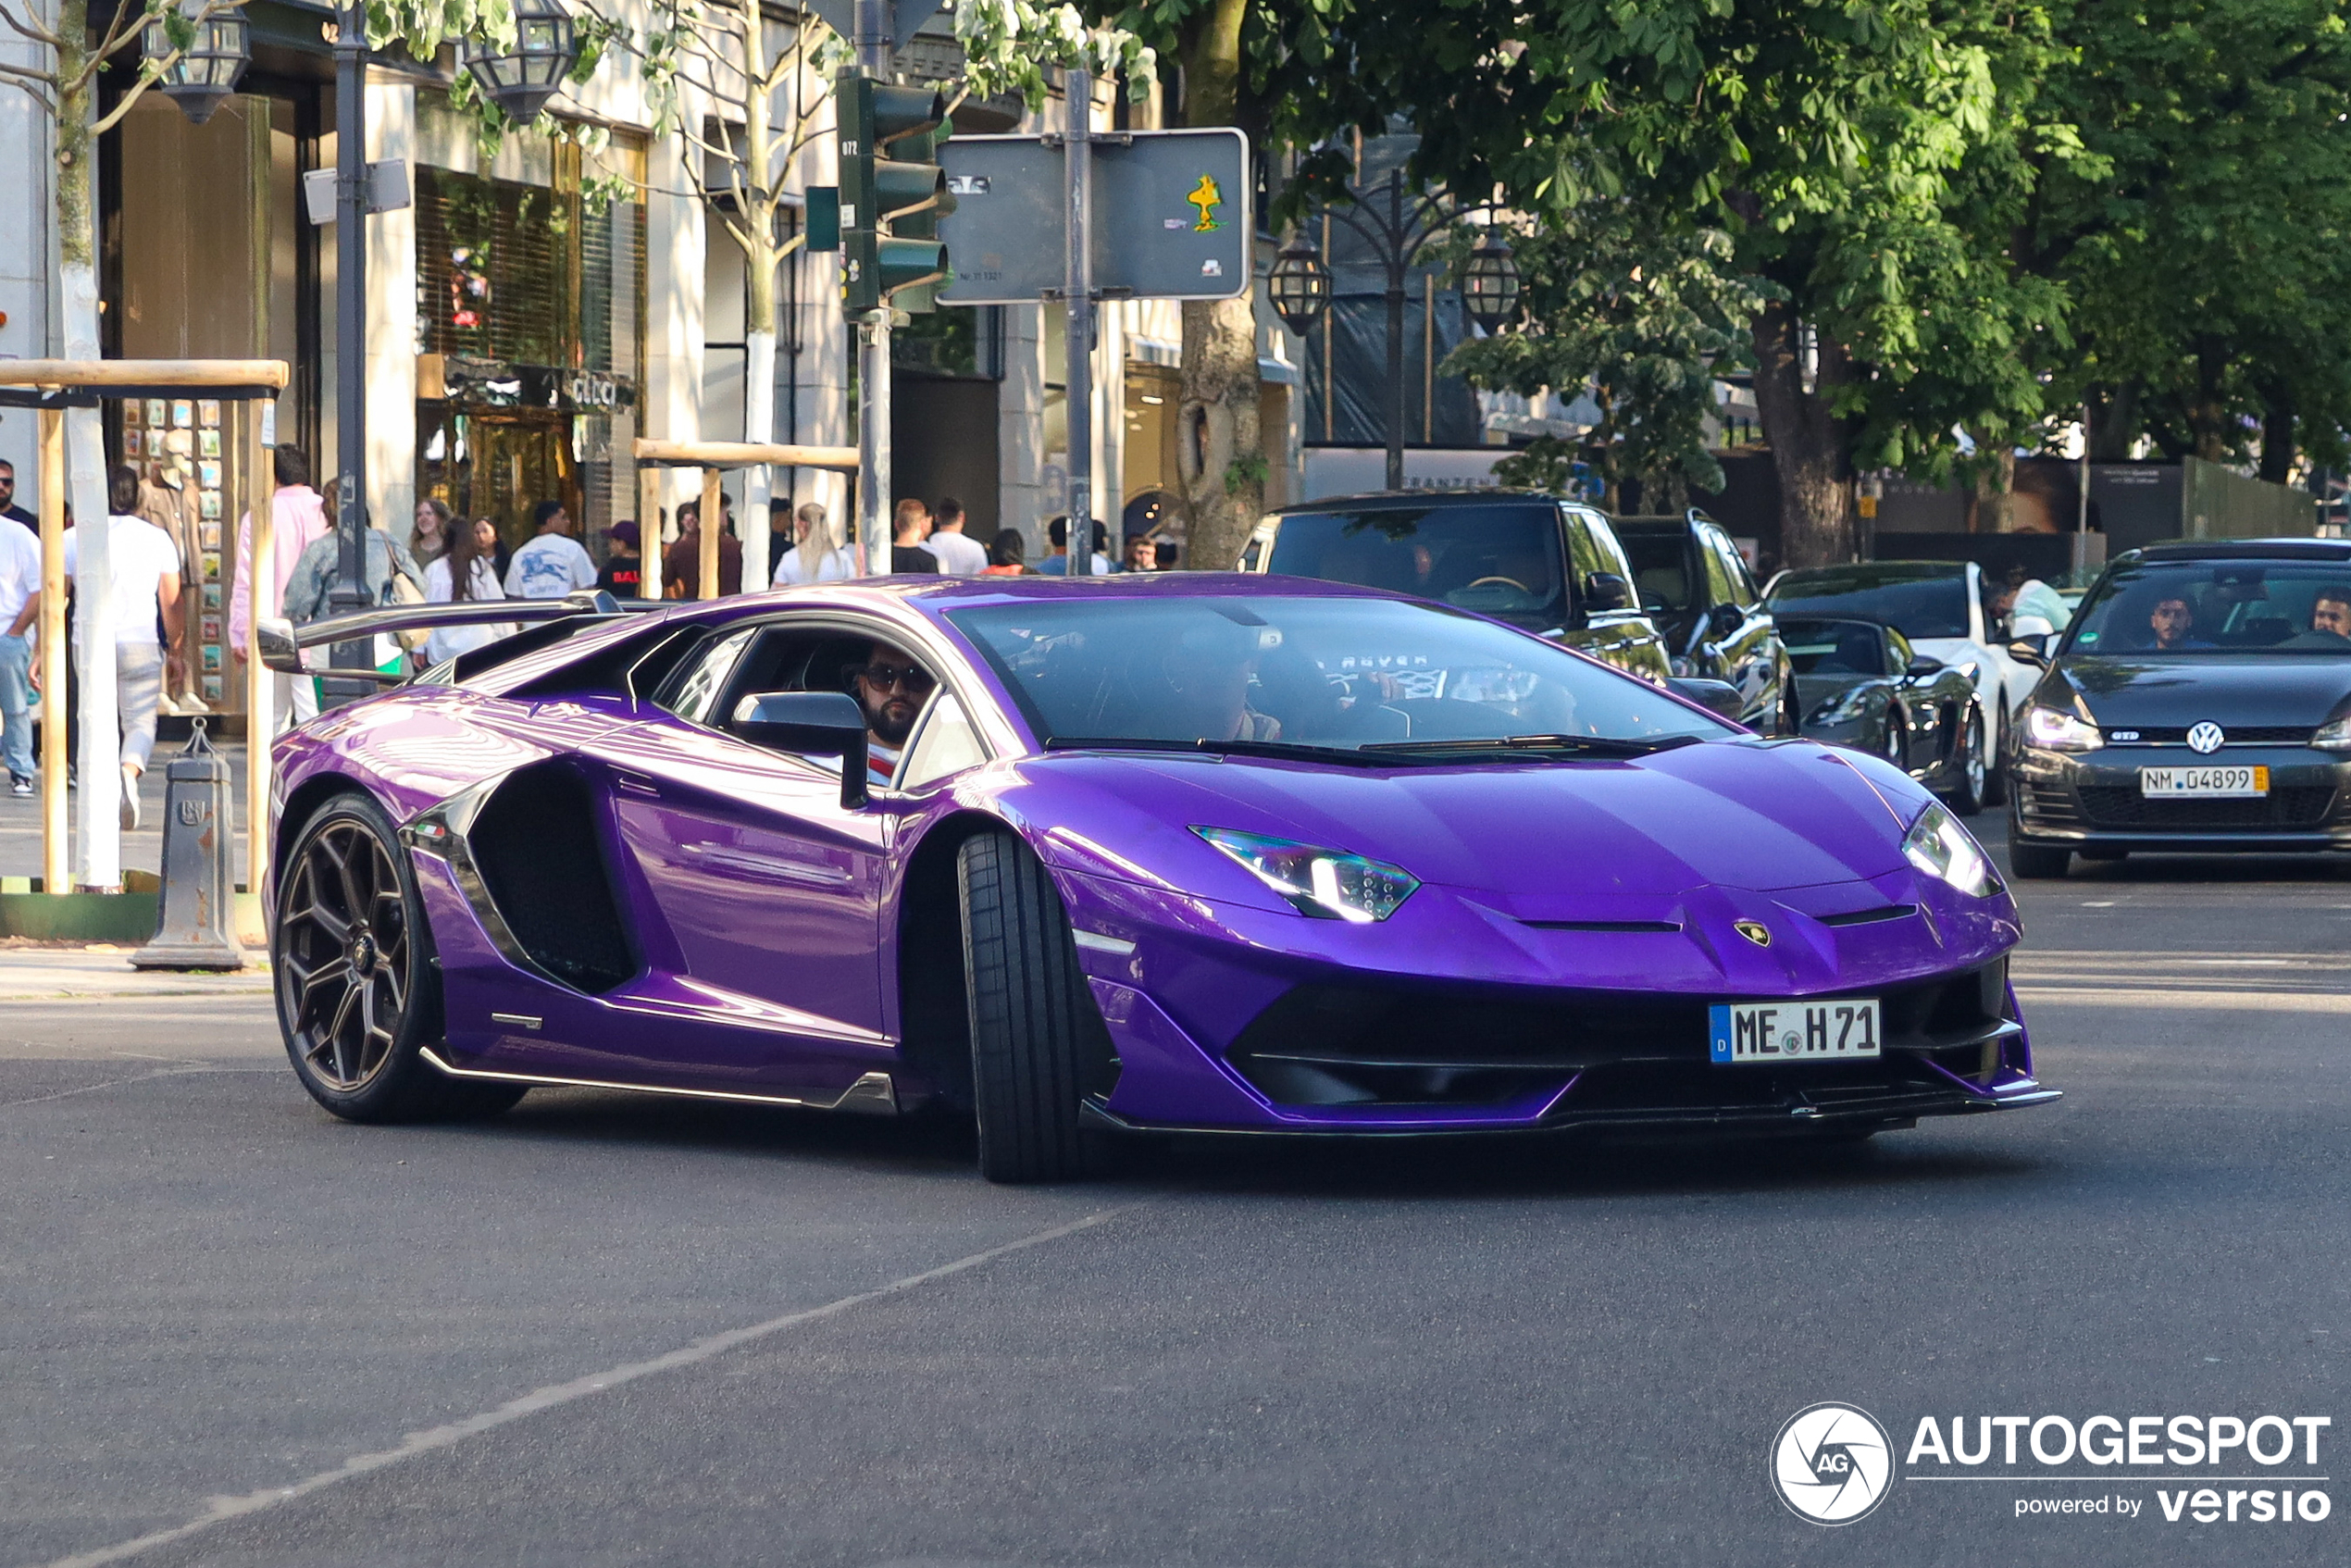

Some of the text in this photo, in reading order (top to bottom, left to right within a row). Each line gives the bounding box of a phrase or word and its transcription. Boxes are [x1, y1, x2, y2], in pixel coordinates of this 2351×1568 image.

[841, 140, 858, 156] 072
[2111, 730, 2140, 740] GTD
[2146, 771, 2172, 790] NM
[2187, 770, 2250, 789] 04899
[1735, 1009, 1780, 1054] ME
[1717, 1039, 1726, 1052] D
